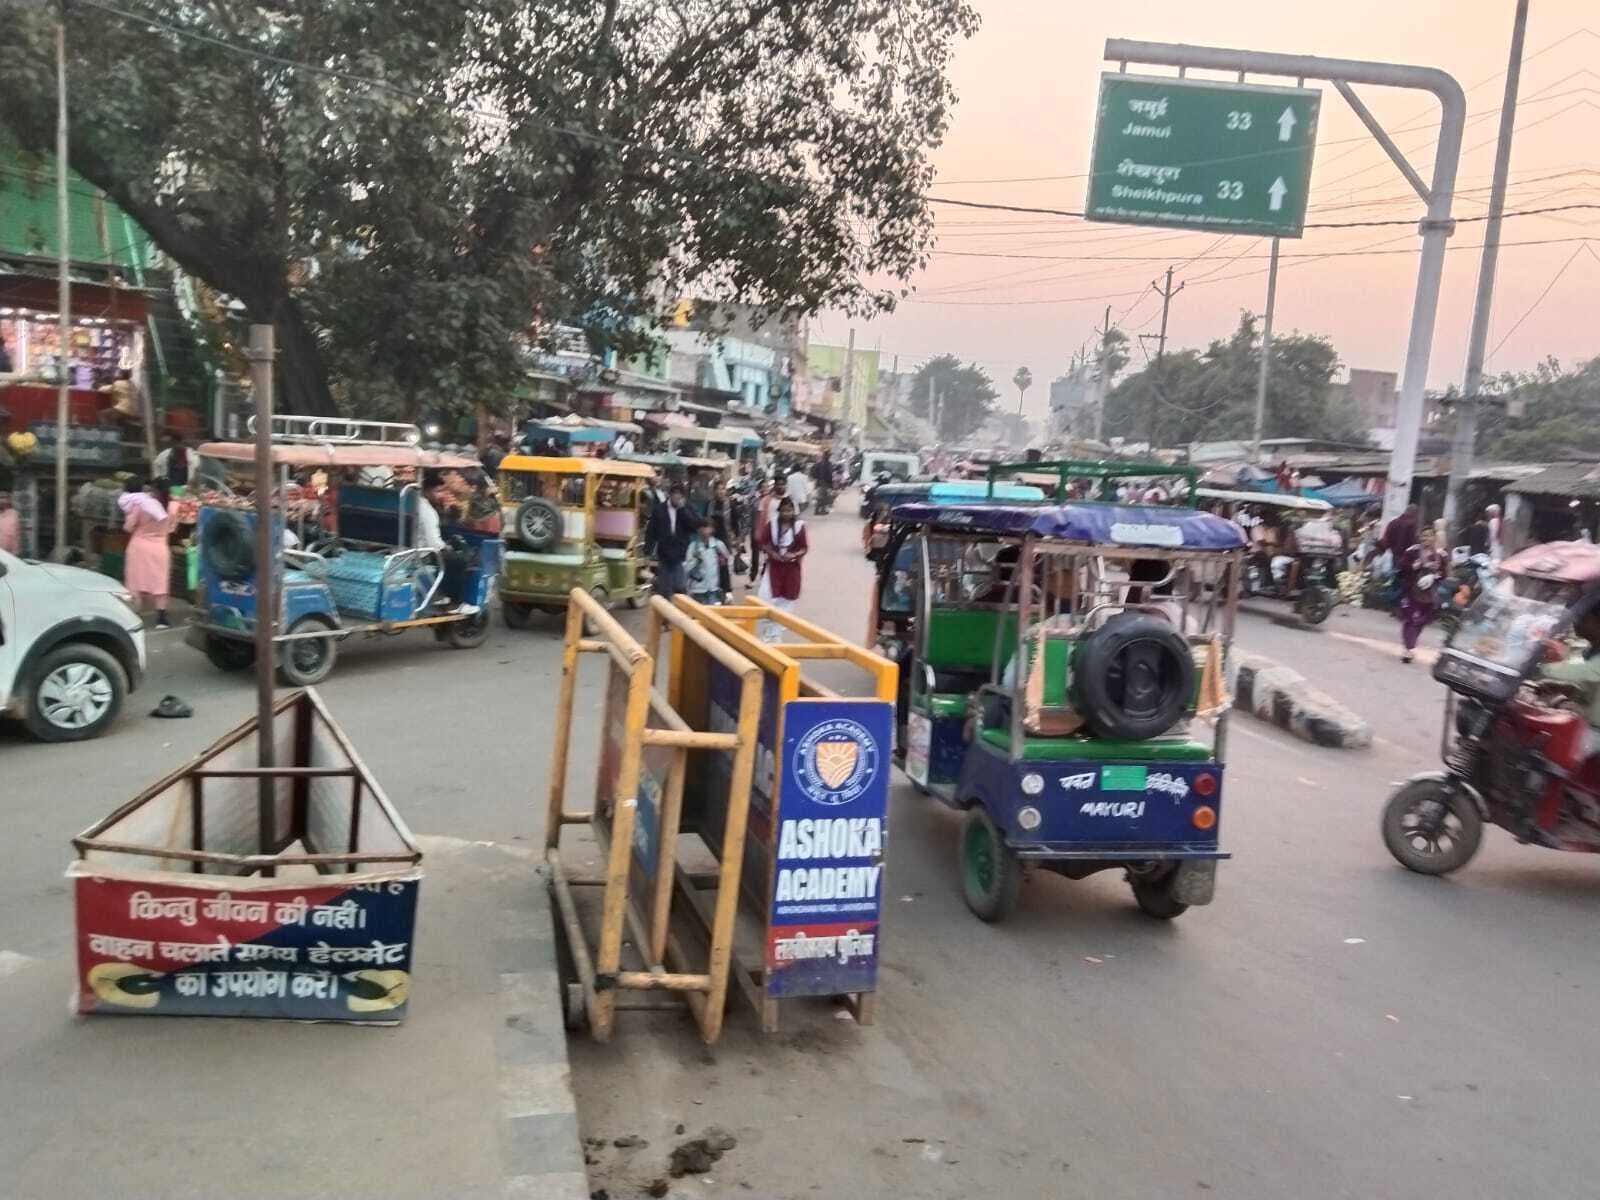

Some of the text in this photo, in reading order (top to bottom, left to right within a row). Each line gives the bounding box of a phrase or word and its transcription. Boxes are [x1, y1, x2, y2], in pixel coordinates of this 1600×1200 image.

[1122, 121, 1172, 138] Jamui
[1226, 111, 1253, 131] 33
[1216, 180, 1244, 201] 33
[1079, 801, 1146, 818] MAYURI
[778, 817, 881, 860] ASHOKA
[776, 867, 880, 901] ACADEMY
[130, 892, 197, 926] किन्तु
[203, 893, 269, 922] जीवन
[274, 896, 309, 926] की
[89, 934, 154, 960] वाहन
[159, 934, 232, 962] चलाते
[234, 942, 300, 963] समय
[174, 973, 208, 997] का
[212, 968, 287, 997] उपयोग
